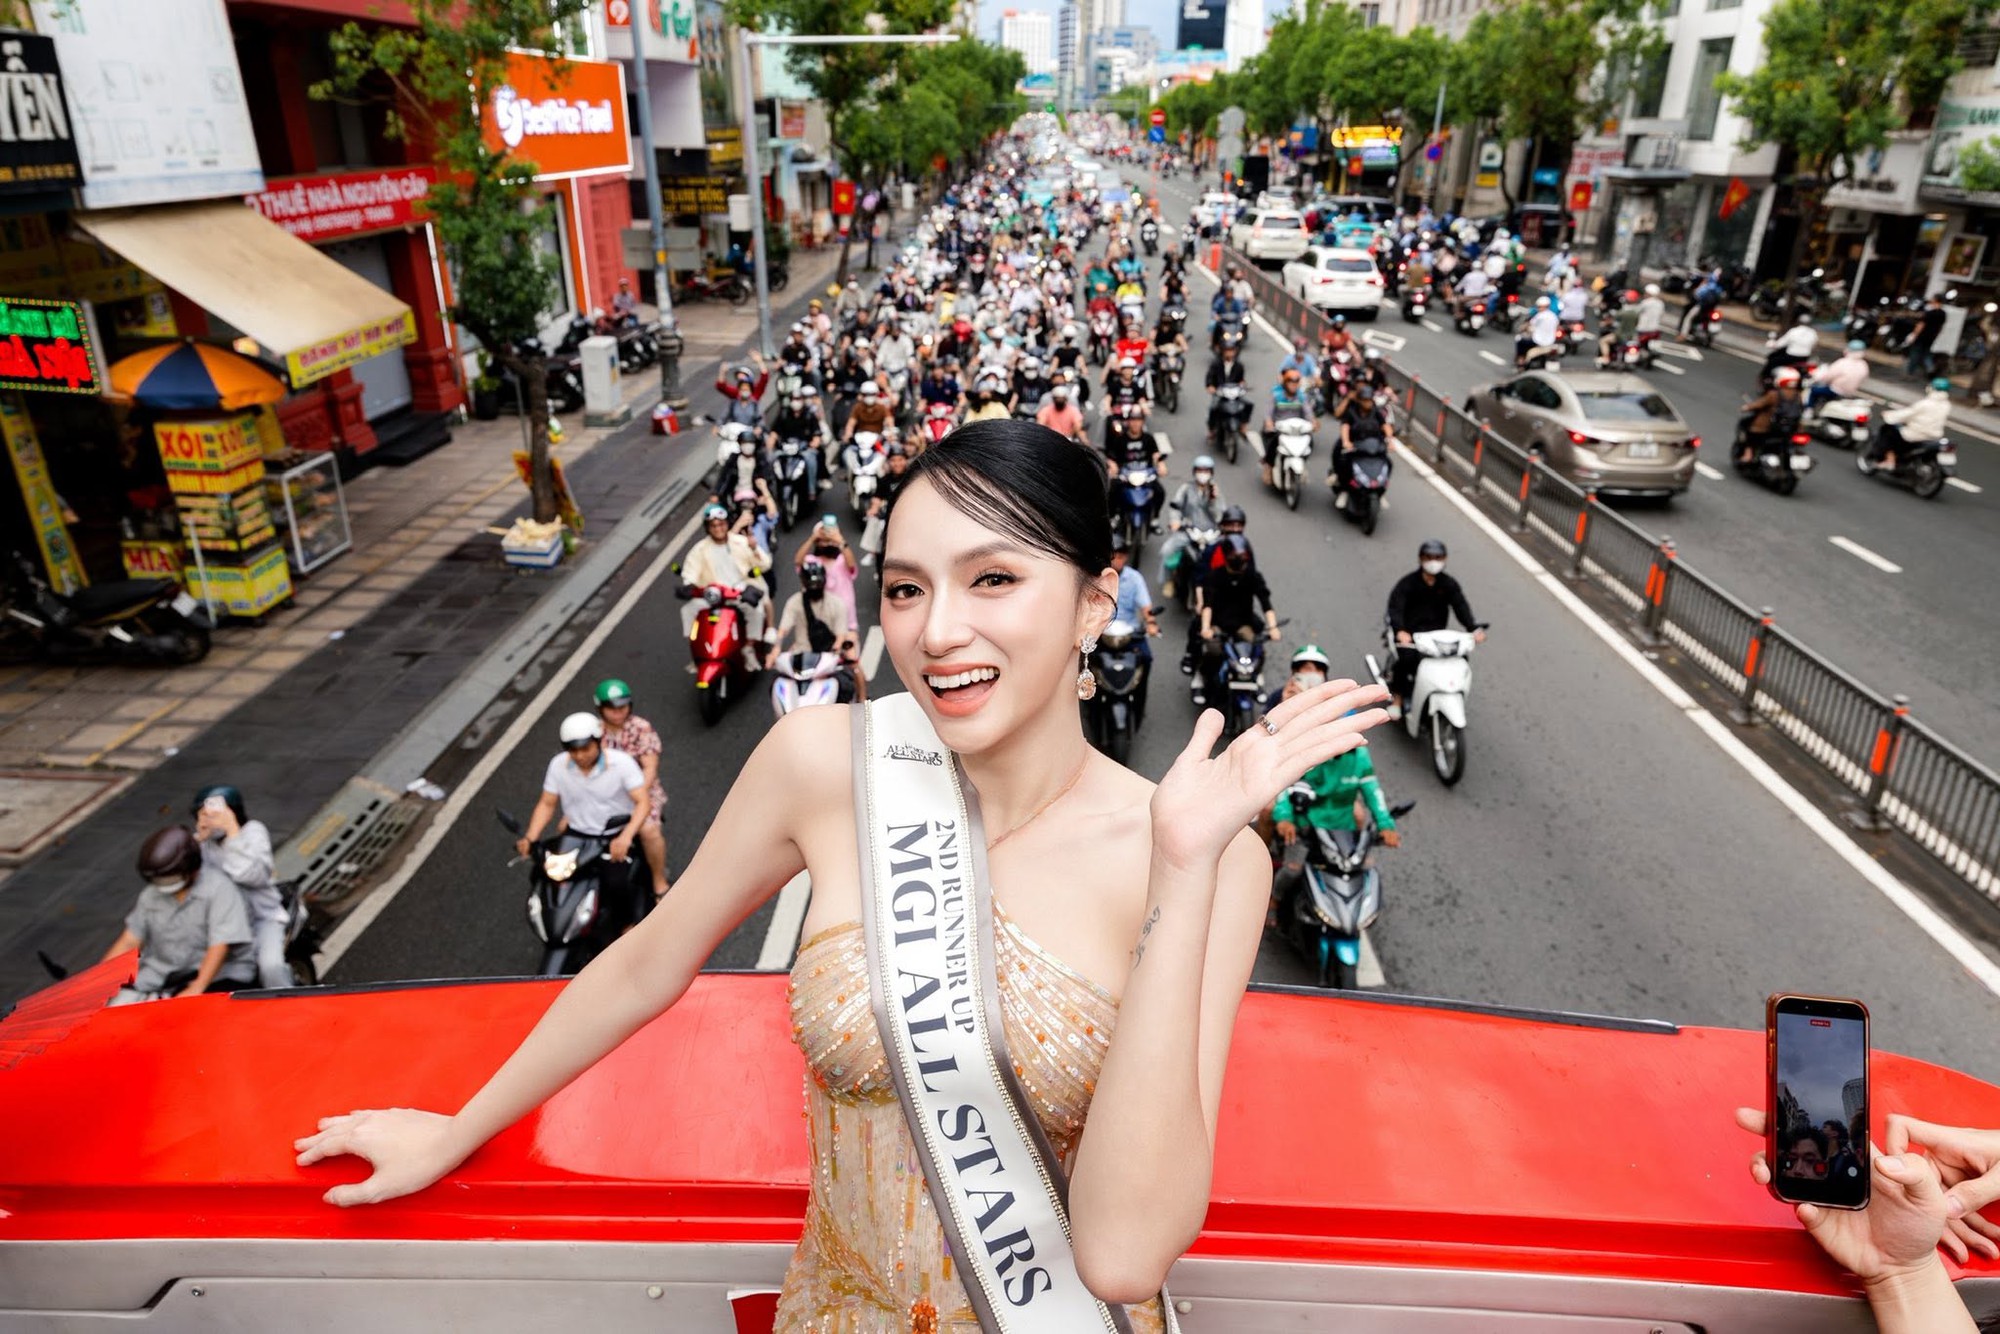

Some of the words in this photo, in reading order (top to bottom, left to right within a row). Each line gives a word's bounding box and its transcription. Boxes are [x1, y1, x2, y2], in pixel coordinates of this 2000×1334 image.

[886, 820, 938, 949] MGI
[935, 819, 959, 870] 2ND
[942, 877, 968, 989] RUNNER
[897, 968, 960, 1094] ALL
[951, 996, 975, 1034] UP
[936, 1103, 1052, 1307] STARS
